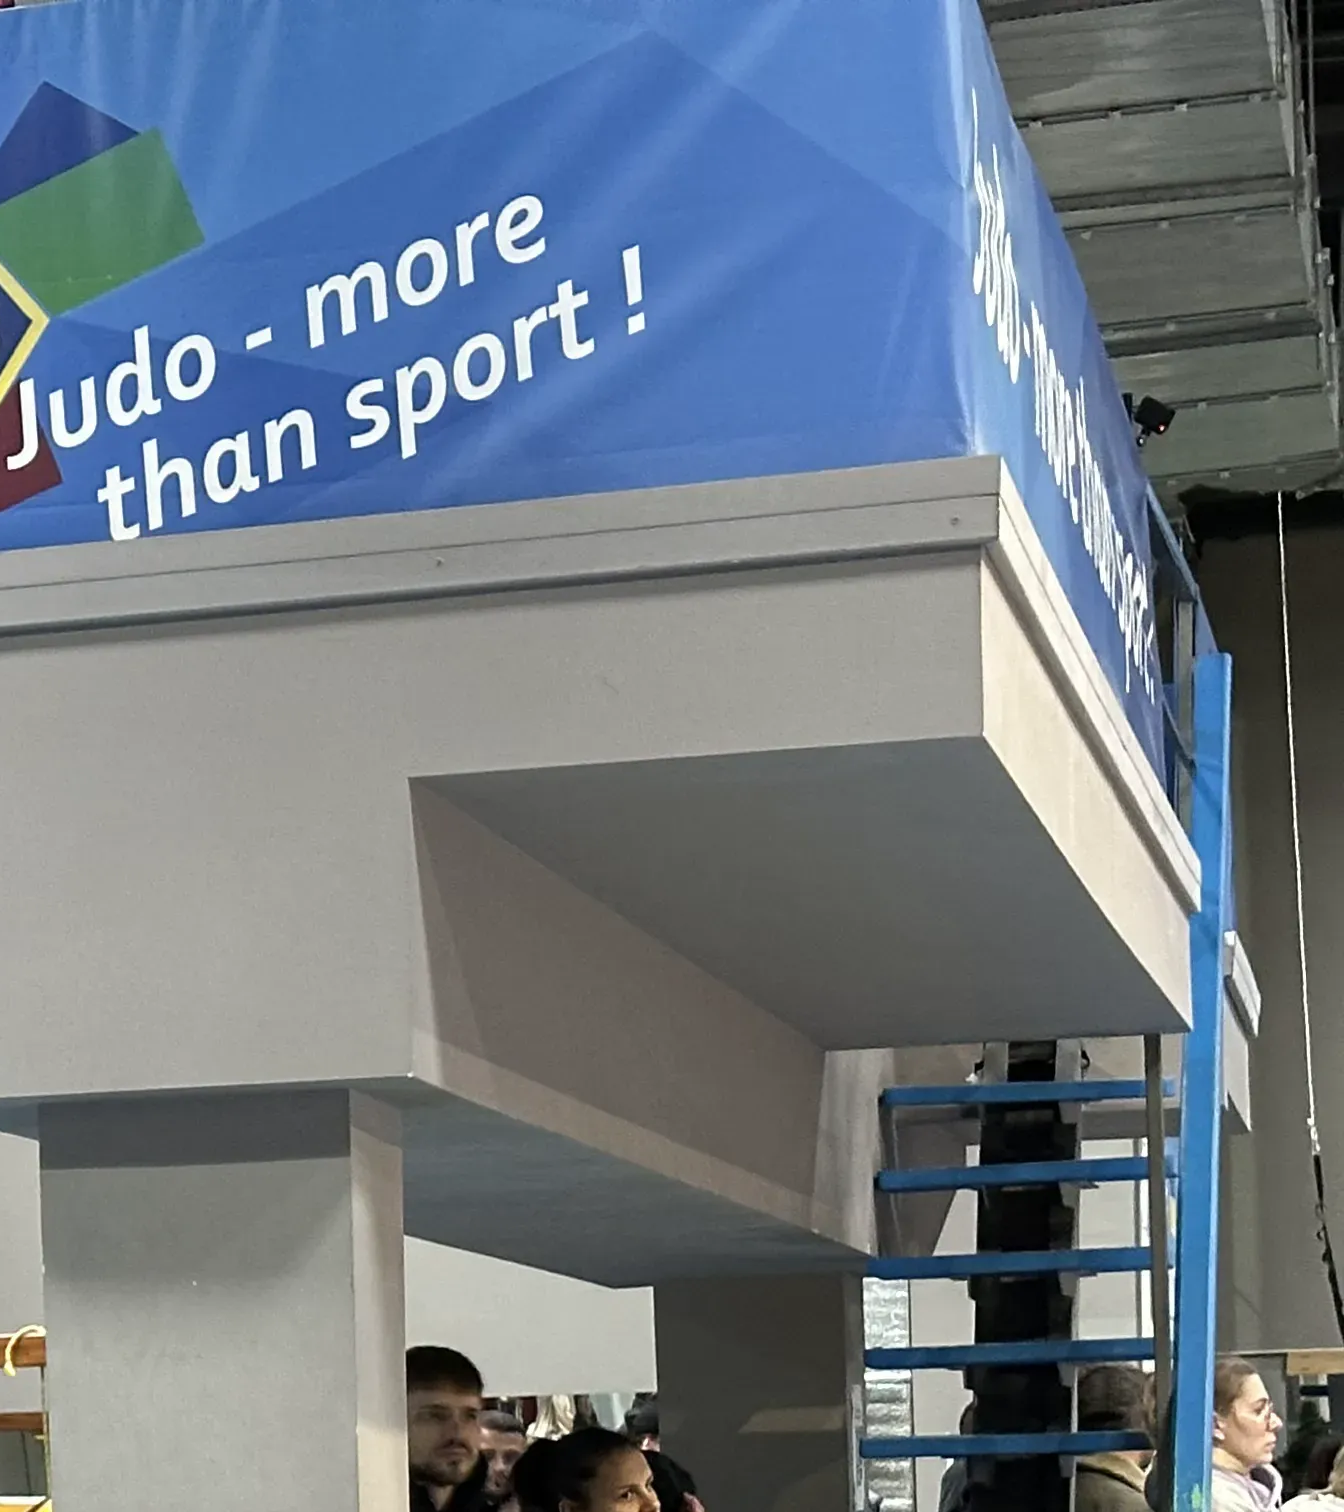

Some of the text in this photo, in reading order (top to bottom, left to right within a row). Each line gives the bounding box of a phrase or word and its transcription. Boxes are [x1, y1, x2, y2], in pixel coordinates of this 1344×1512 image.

[6, 195, 546, 471] Judo - more
[97, 245, 647, 542] than sport !
